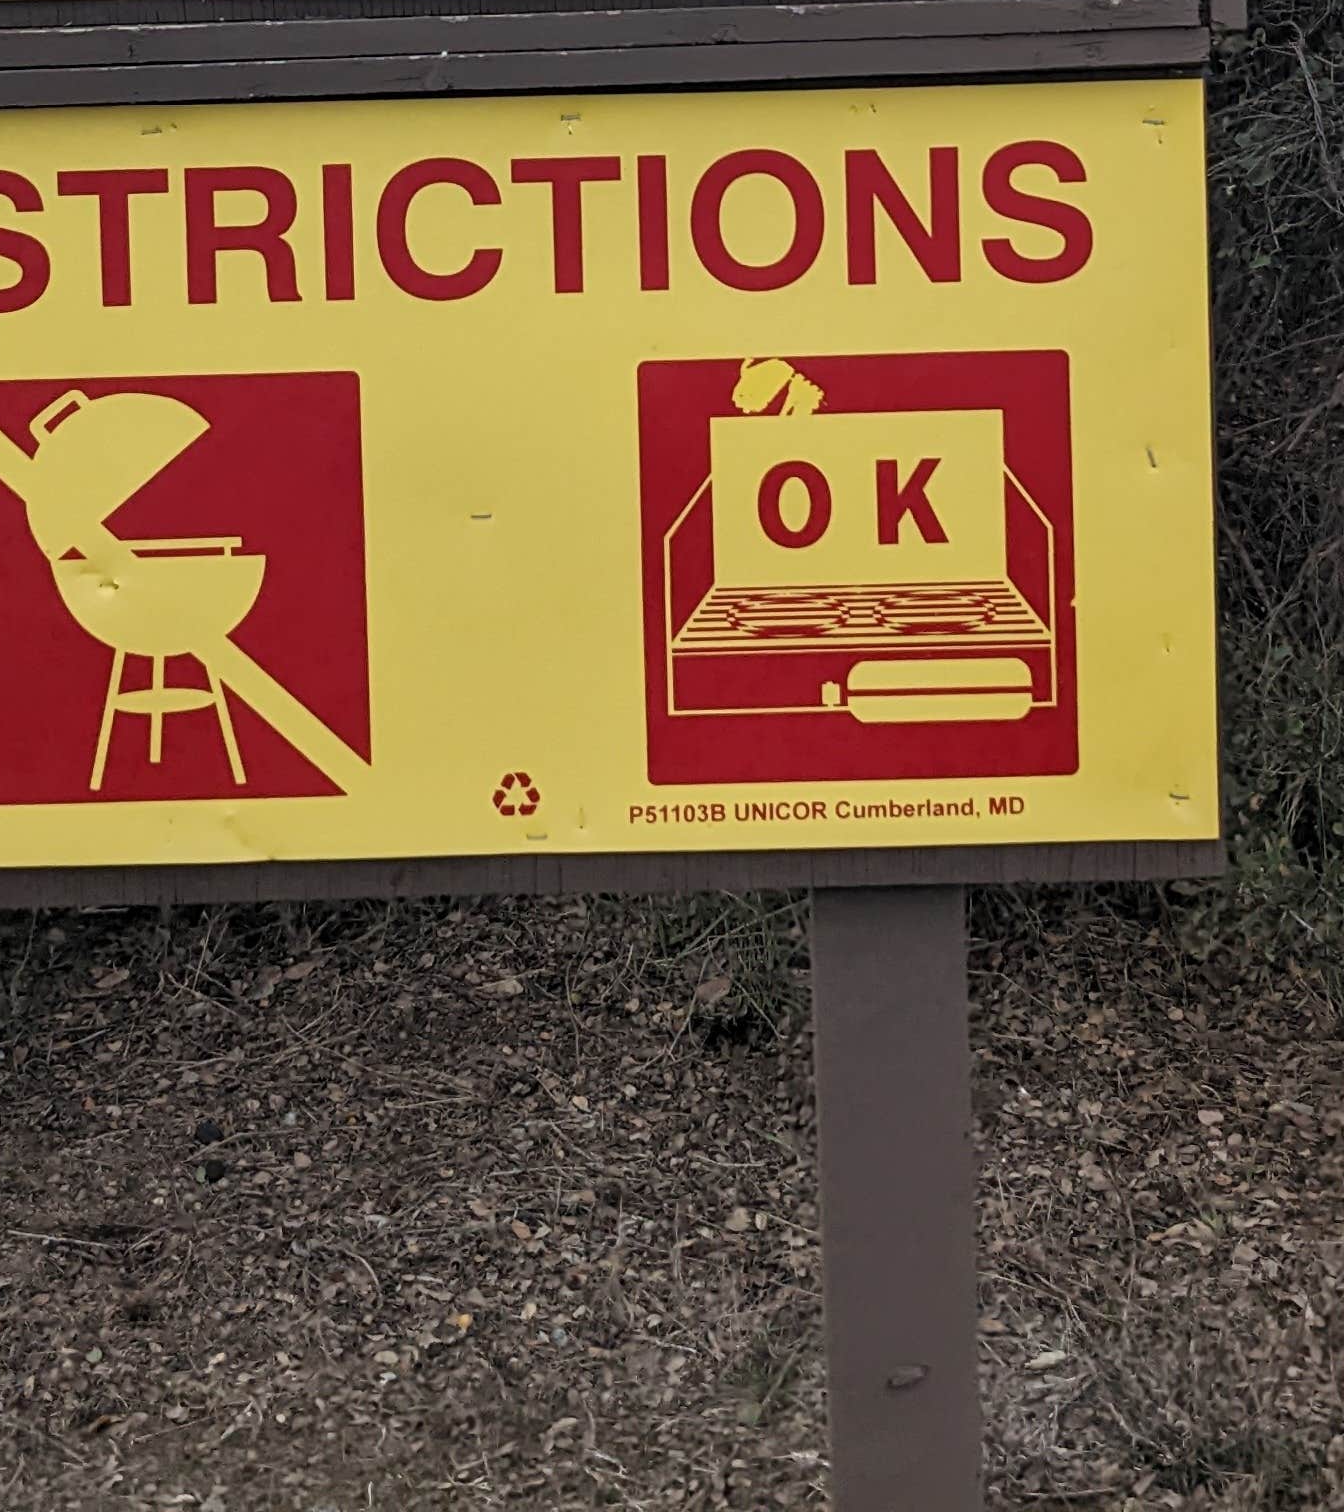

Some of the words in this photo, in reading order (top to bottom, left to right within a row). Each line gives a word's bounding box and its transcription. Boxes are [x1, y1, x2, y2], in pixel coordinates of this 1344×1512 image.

[630, 804, 725, 824] P51103B
[735, 802, 827, 821] UNICOR
[836, 798, 981, 820] Cumberland,
[989, 797, 1024, 814] MD
